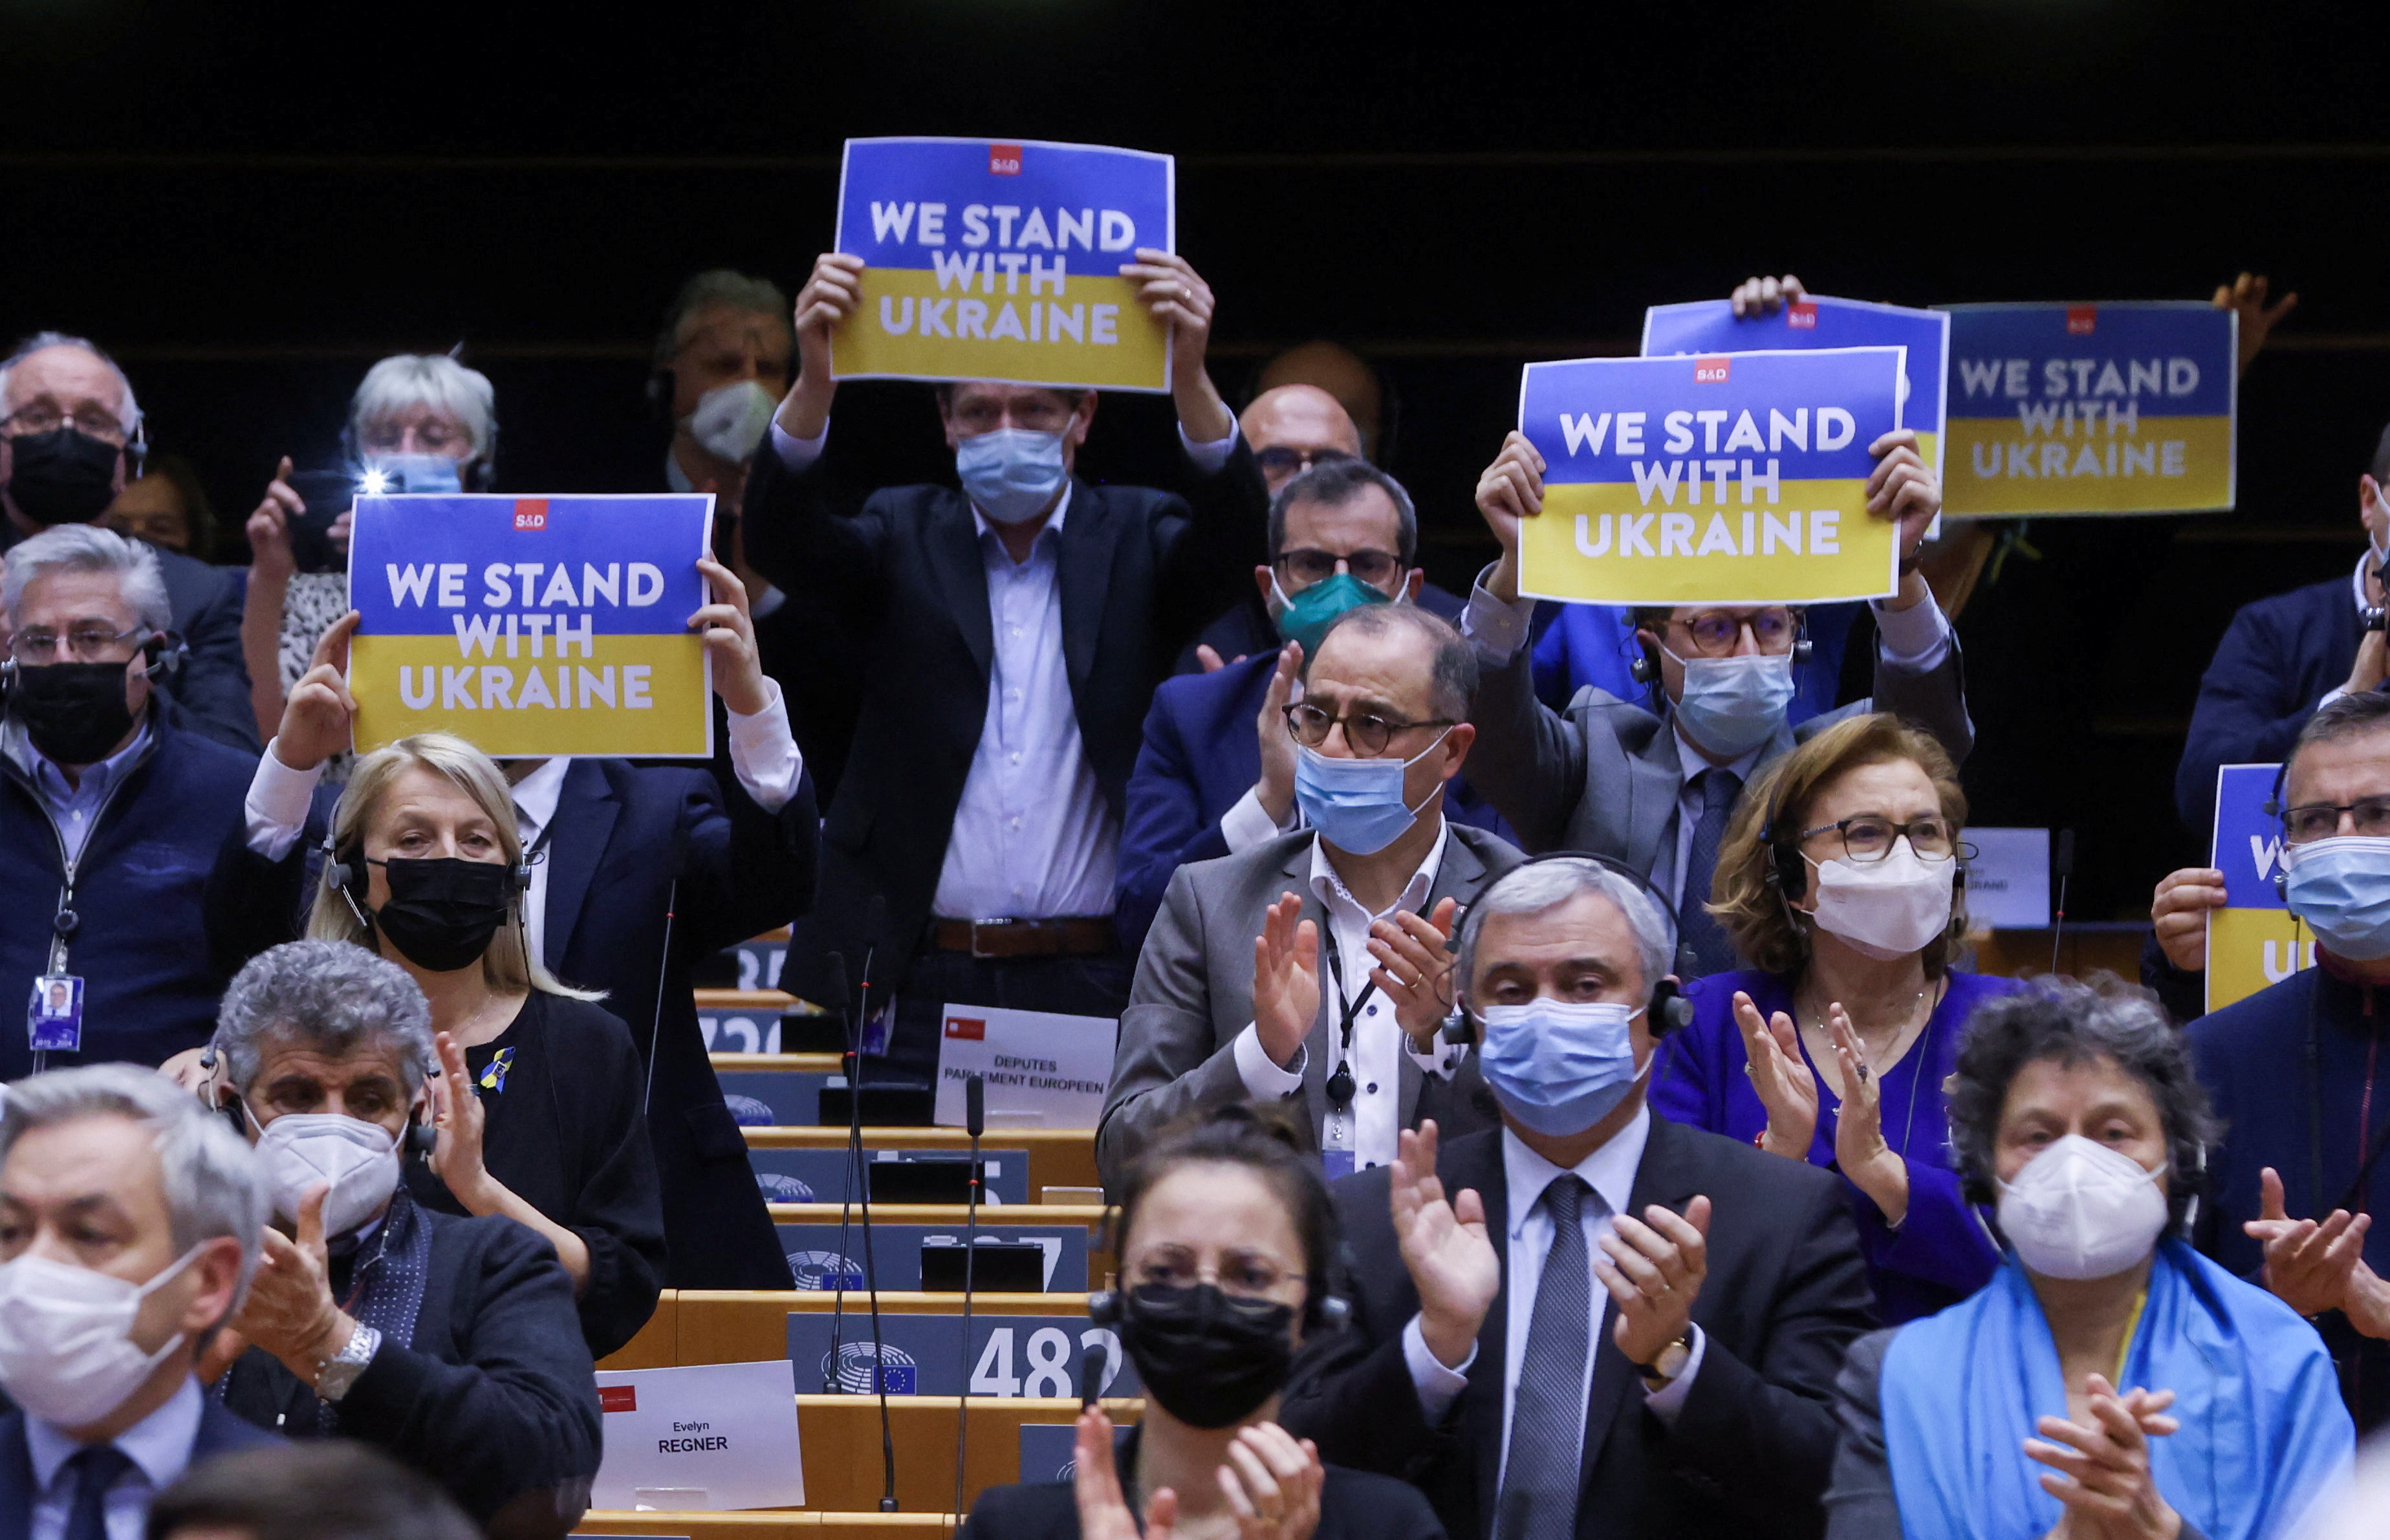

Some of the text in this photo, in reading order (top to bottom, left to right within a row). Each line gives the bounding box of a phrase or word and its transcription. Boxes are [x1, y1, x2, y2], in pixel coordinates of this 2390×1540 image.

[871, 201, 1136, 252] WE STAND
[931, 250, 1067, 297] WITH
[879, 296, 1120, 345] UKRAINE
[1697, 368, 1726, 380] S&D
[1959, 358, 2200, 397] WE STAND
[1559, 406, 1856, 457] WE STAND
[2018, 400, 2139, 438] WITH
[1972, 440, 2187, 479] UKRAINE
[1631, 458, 1781, 506] WITH
[516, 514, 545, 527] S&D
[1574, 510, 1841, 558] UKRAINE
[386, 561, 664, 608] WE STAND
[453, 613, 593, 658] WITH
[399, 664, 653, 710] UKRAINE
[944, 1068, 1103, 1094] PAREMENT EUROPEEN
[994, 1055, 1057, 1072] DEPUTES
[658, 1437, 728, 1453] REGNER
[673, 1420, 710, 1433] Evelyn
